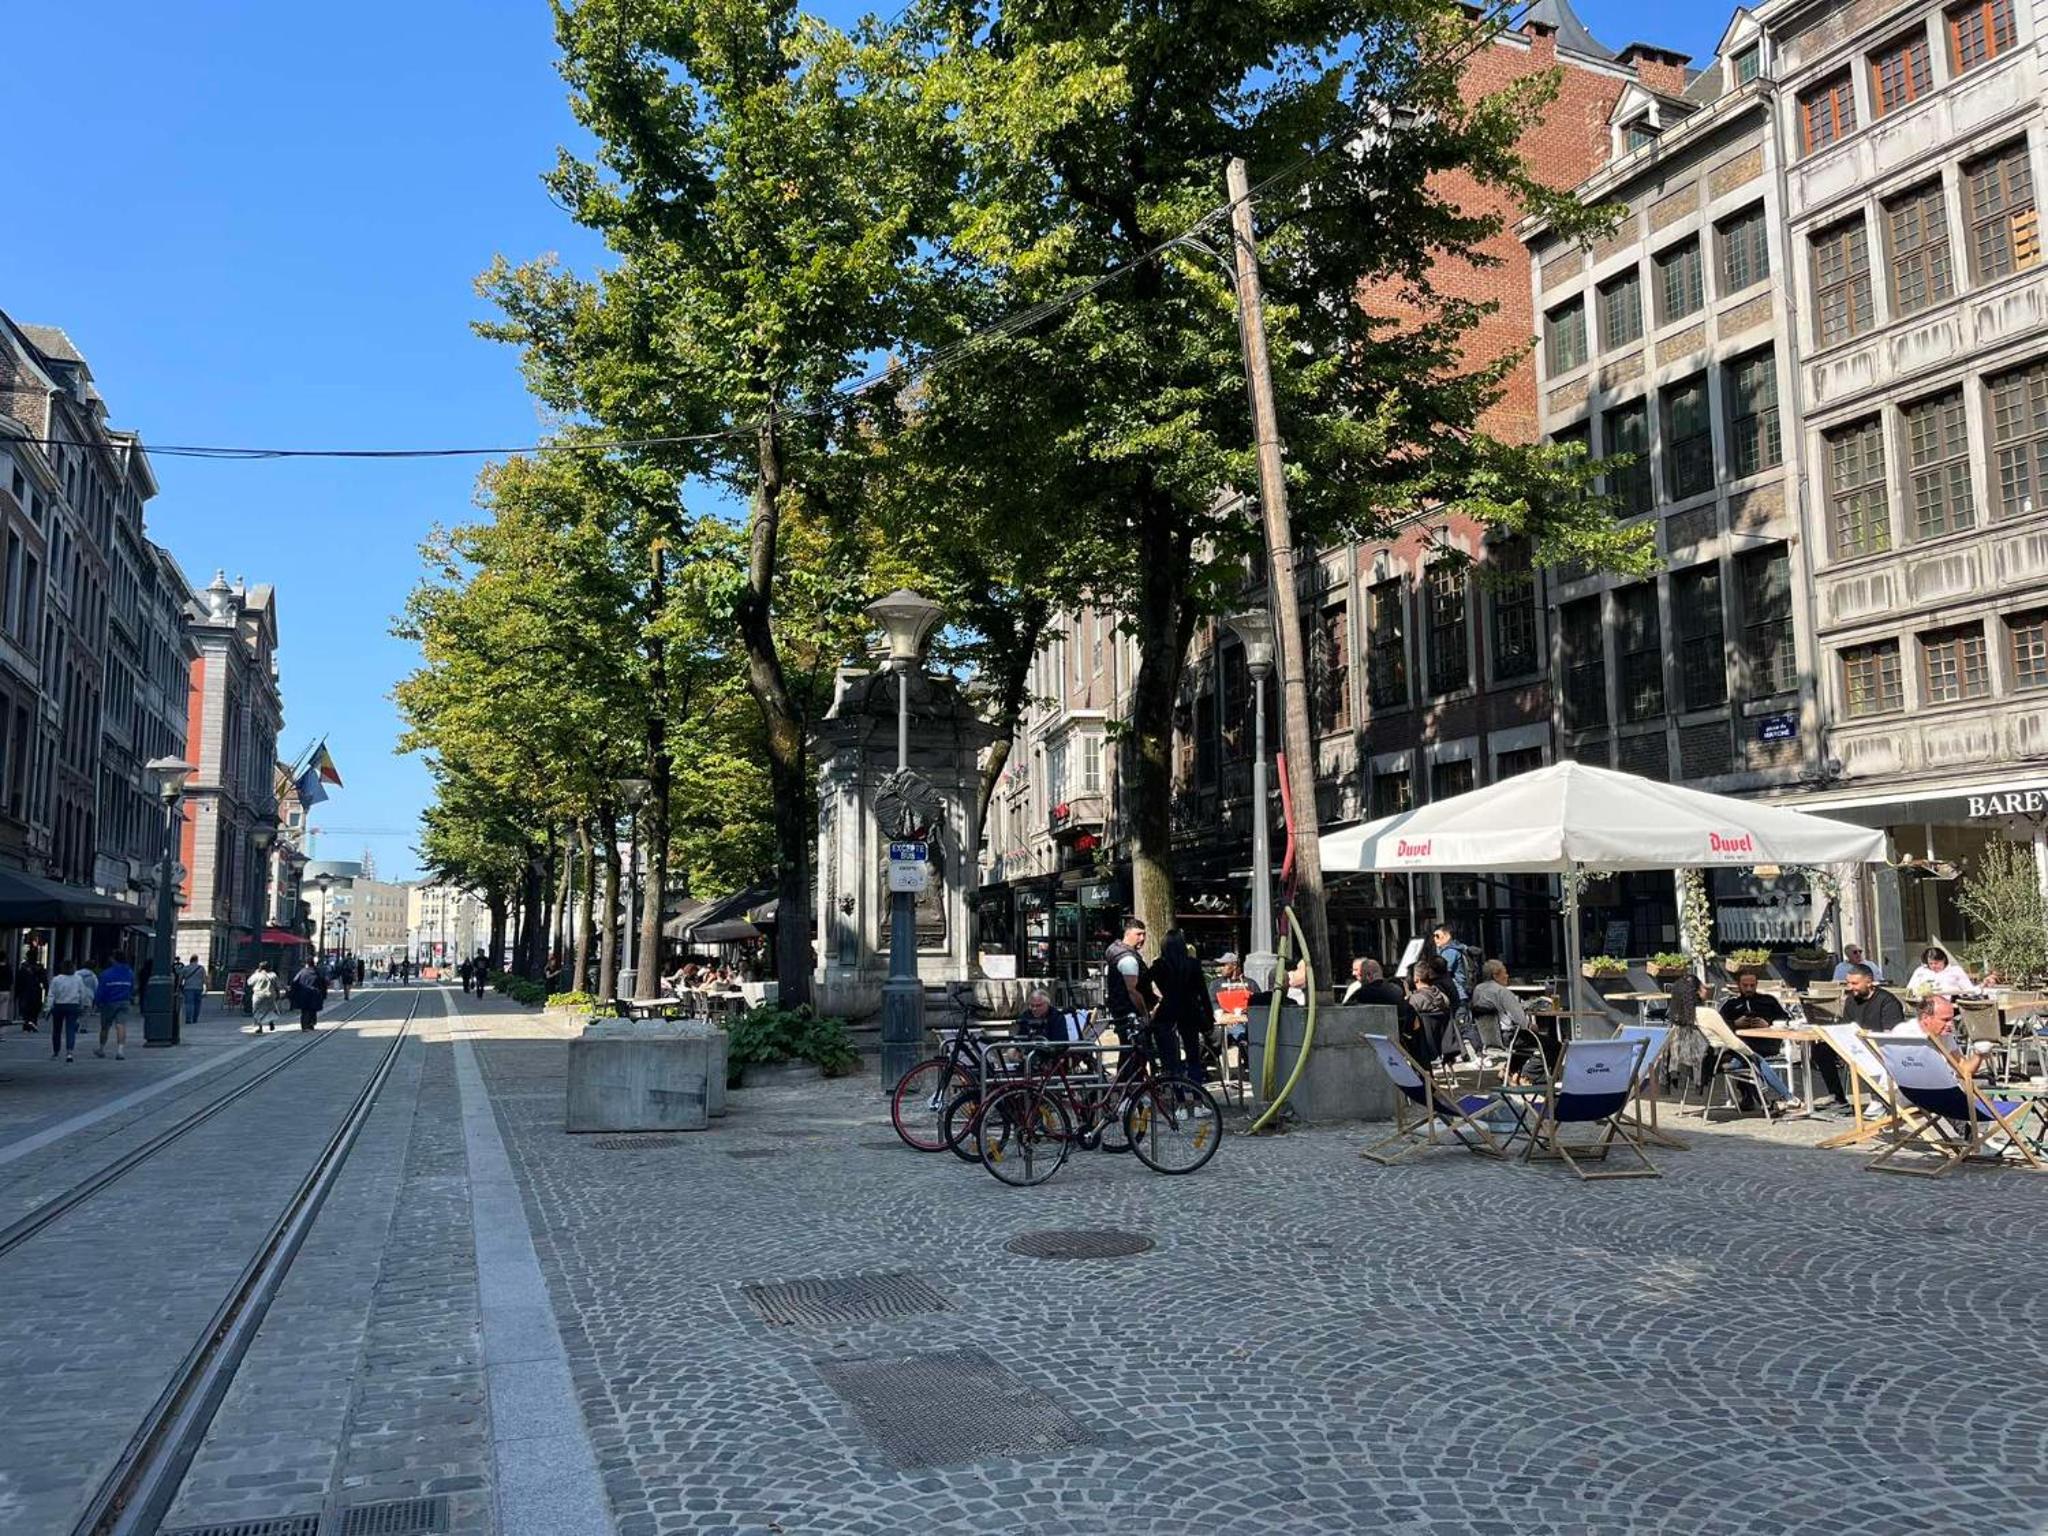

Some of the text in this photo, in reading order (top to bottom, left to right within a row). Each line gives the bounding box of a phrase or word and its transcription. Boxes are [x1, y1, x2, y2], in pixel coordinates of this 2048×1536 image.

[1967, 789, 2048, 817] BARE
[1398, 839, 1431, 857] Duvel
[1709, 833, 1752, 851] Duvel
